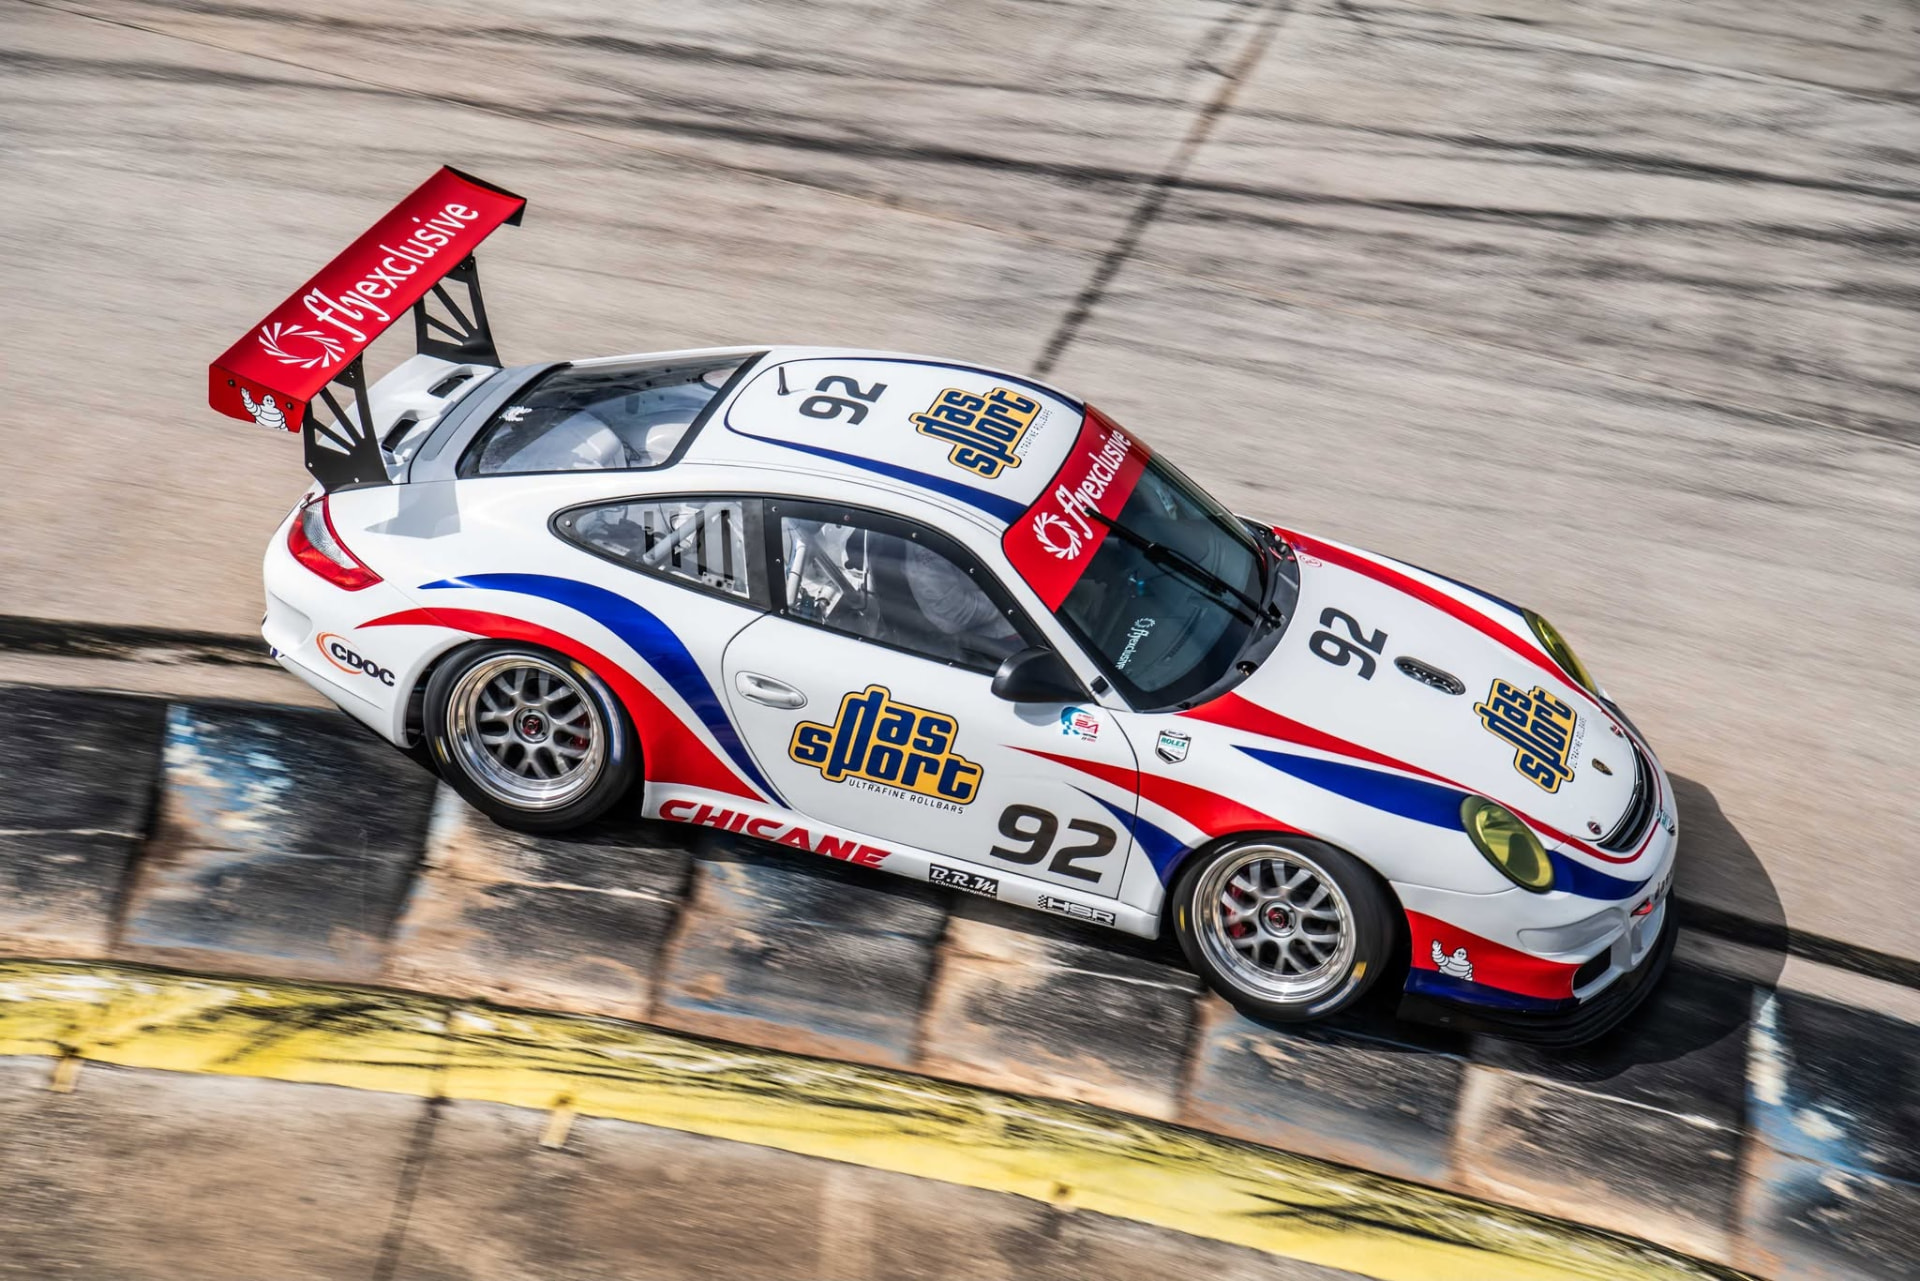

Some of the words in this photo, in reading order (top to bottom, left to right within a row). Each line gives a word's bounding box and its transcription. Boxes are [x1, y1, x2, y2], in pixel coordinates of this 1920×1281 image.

[303, 203, 478, 343] flyexclusive
[799, 375, 888, 425] 92
[1055, 430, 1132, 540] flyexclusive
[330, 641, 395, 687] CDOC
[1309, 607, 1389, 681] 92
[848, 778, 905, 800] ULTRAFINE
[909, 794, 965, 815] ROLLBARS
[659, 799, 893, 869] CHICANE
[989, 804, 1117, 884] 92
[930, 865, 998, 894] B.R.M
[1048, 897, 1115, 924] HSR
